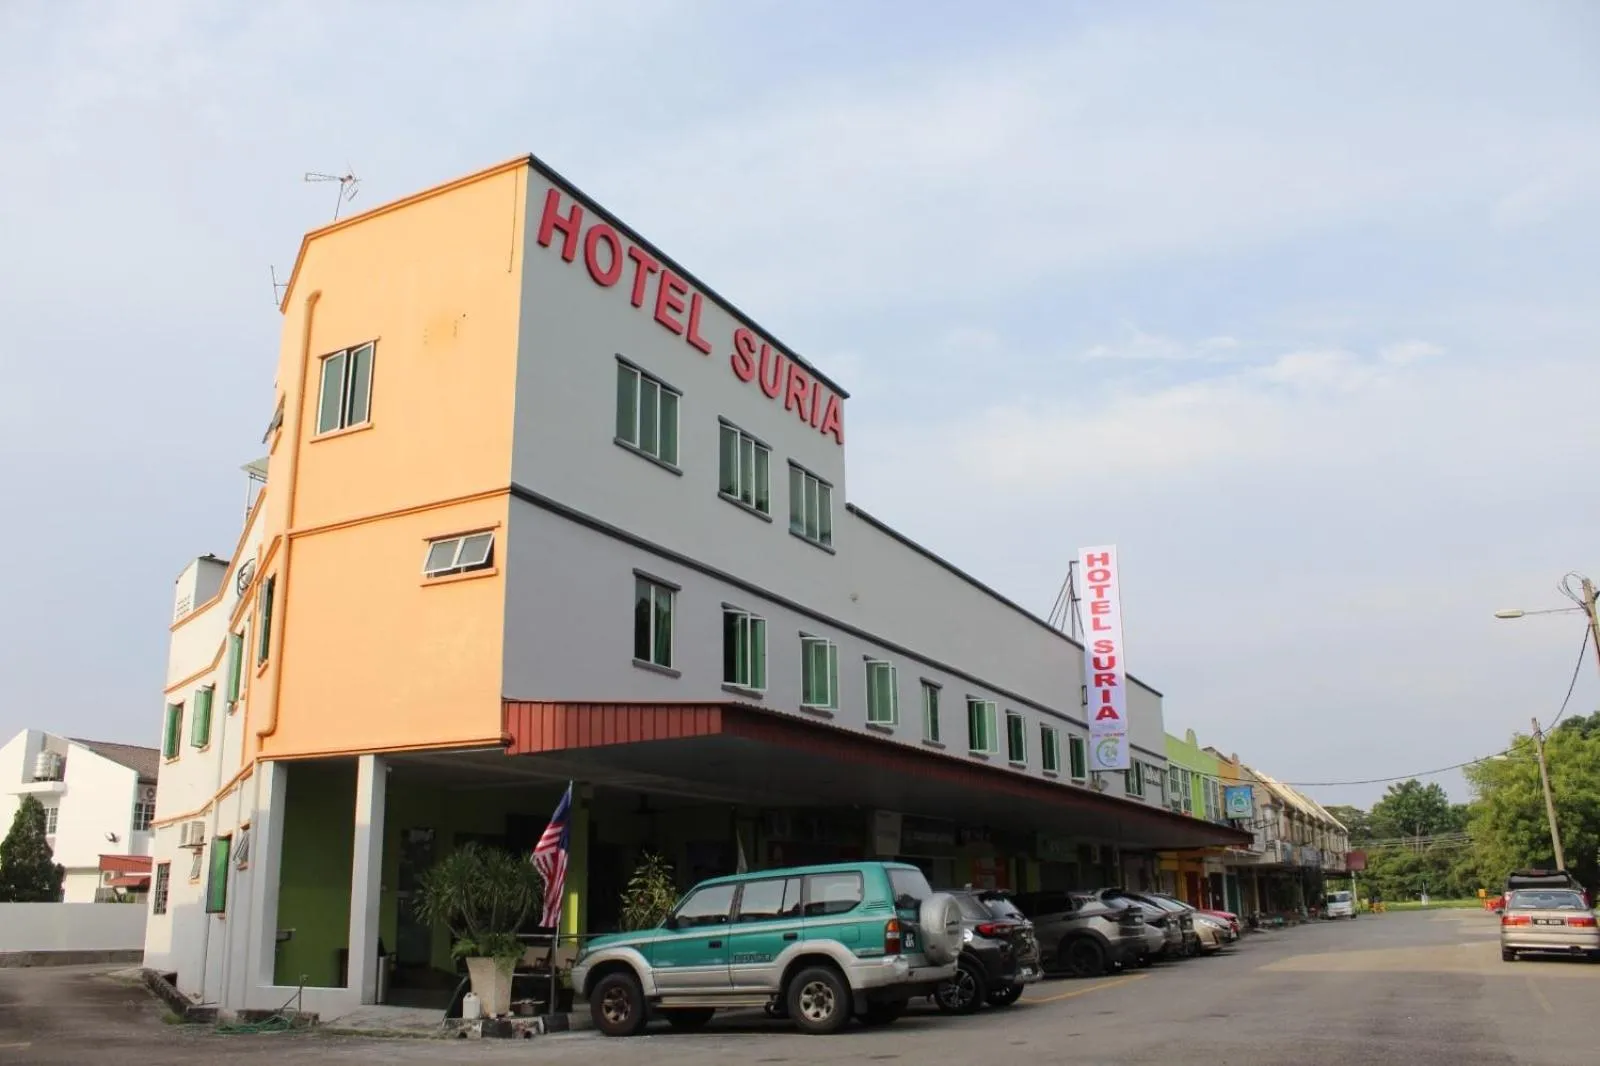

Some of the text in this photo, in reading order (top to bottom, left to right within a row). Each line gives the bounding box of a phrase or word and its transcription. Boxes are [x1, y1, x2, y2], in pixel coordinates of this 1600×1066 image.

[536, 187, 845, 446] HOTEL SURIA
[1086, 552, 1112, 632] HOTEL
[1092, 639, 1120, 721] SURIA
